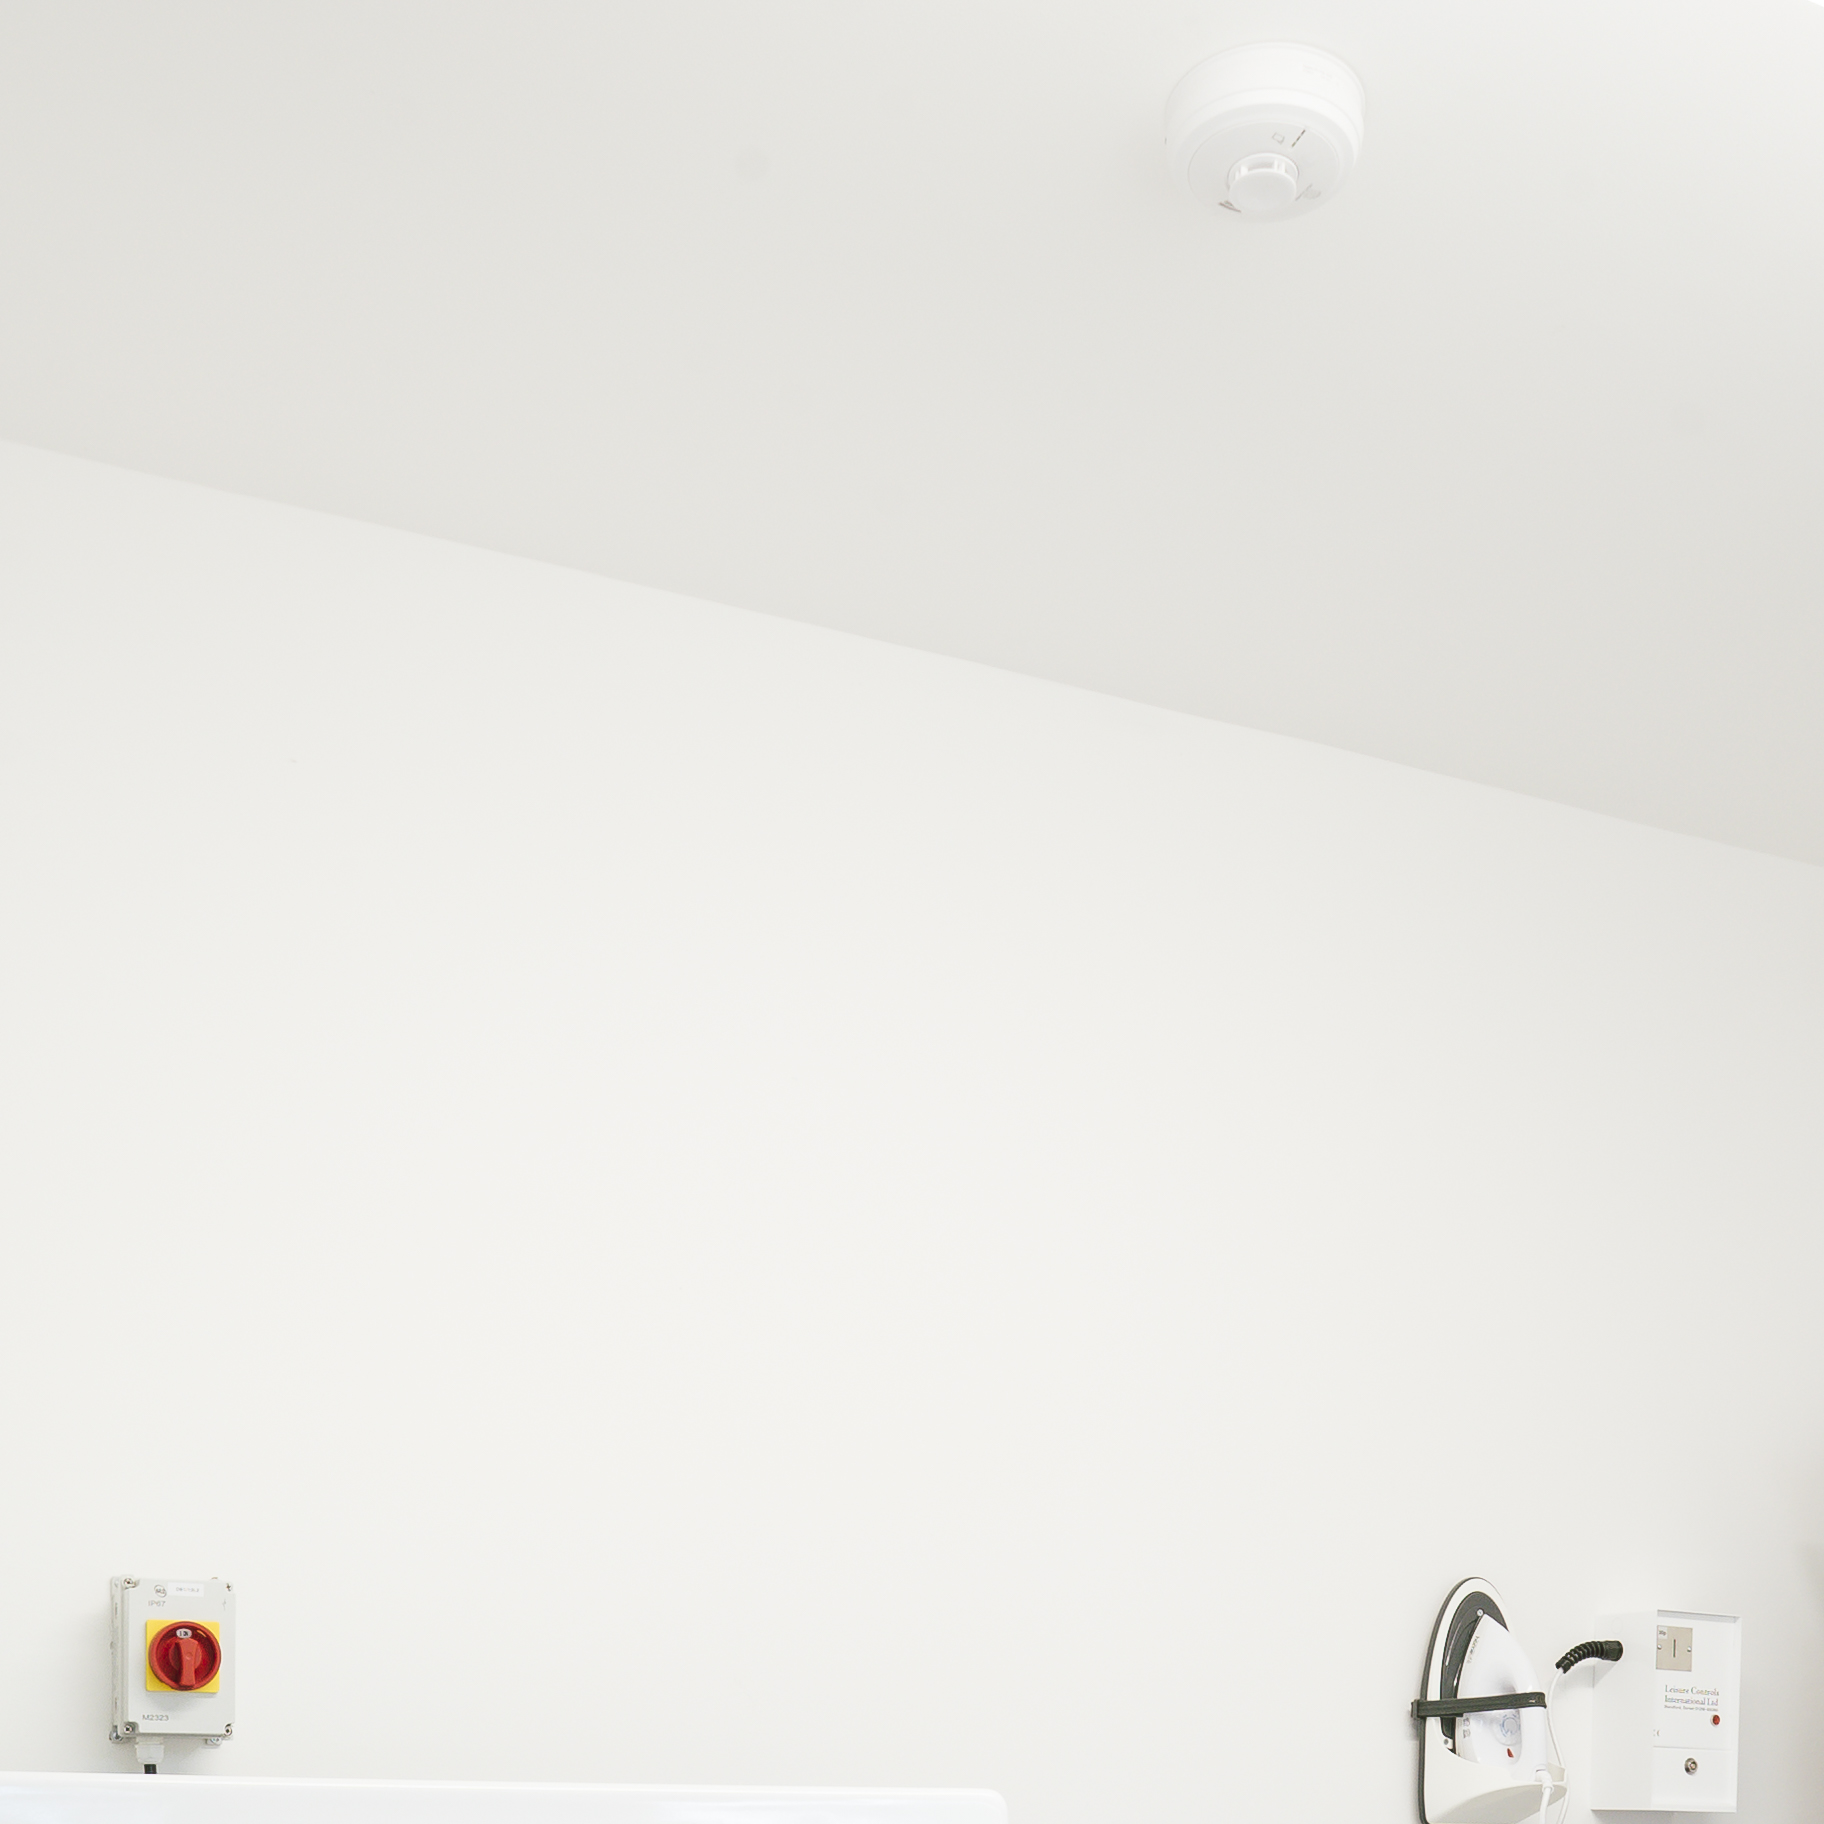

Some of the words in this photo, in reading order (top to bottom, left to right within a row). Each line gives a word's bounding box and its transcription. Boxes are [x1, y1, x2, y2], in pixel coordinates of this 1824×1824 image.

[1665, 1685, 1689, 1694] Leisure
[1691, 1686, 1719, 1696] Controls
[1665, 1695, 1705, 1705] International
